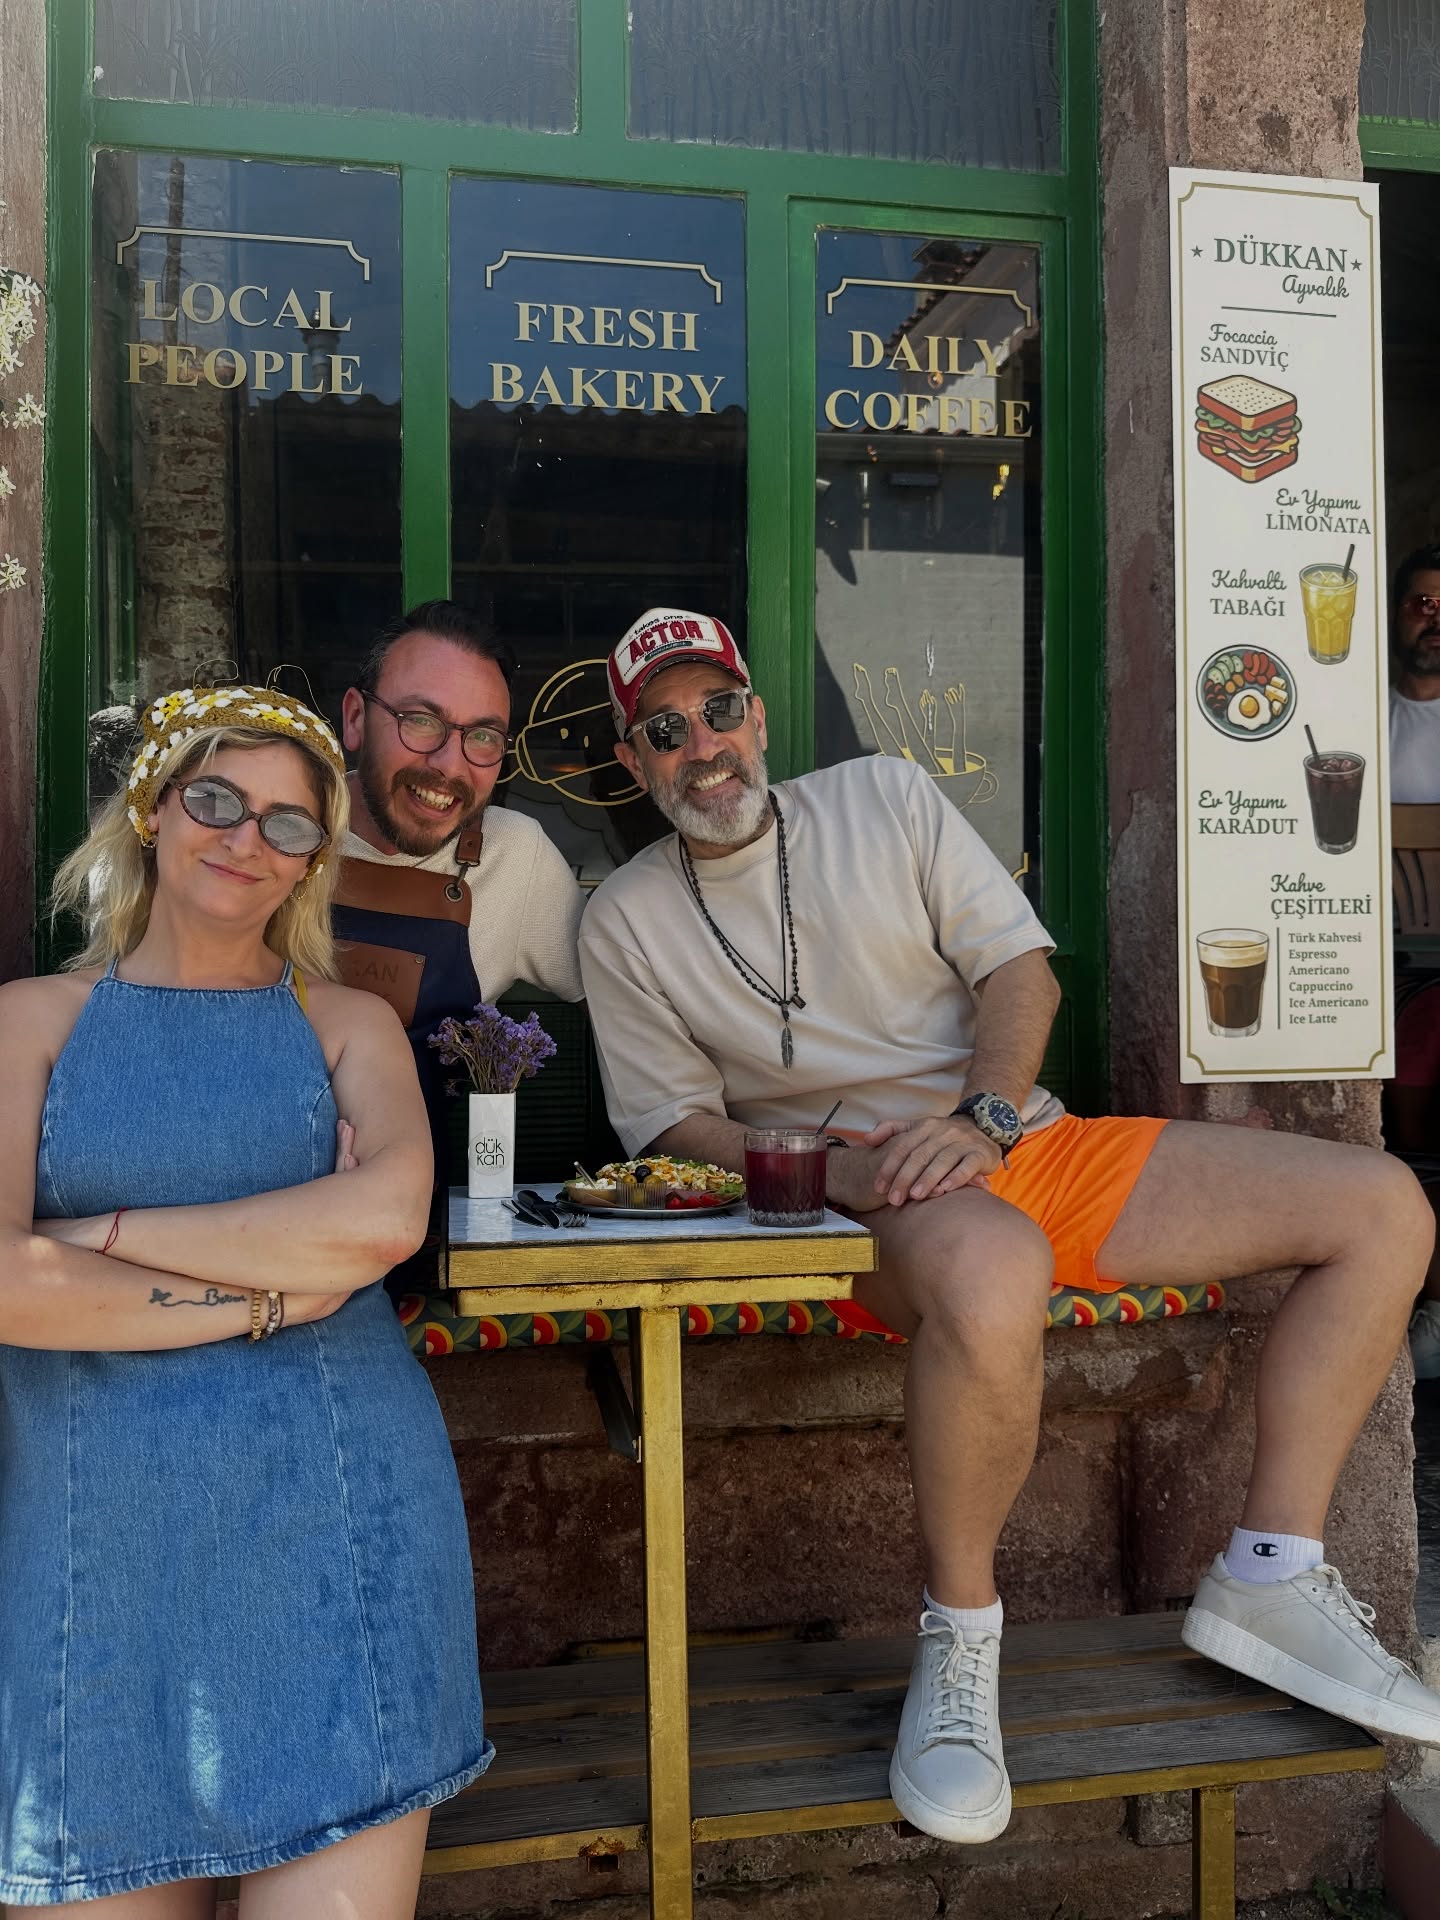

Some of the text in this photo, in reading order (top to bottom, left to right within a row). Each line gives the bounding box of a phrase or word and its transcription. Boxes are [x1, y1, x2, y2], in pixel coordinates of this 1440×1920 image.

[1214, 234, 1348, 273] DÜKKAN
[1282, 274, 1350, 304] Ayvalık
[140, 279, 352, 333] LOCAL
[514, 302, 701, 352] FRESH
[1208, 323, 1278, 346] Focaccia
[848, 330, 1003, 378] DAILY
[1200, 346, 1289, 372] SANDVİÇ
[124, 343, 364, 396] PEOPLE
[488, 363, 726, 414] BAKERY
[825, 389, 1033, 438] COFFEE
[1276, 488, 1361, 517] Ev Yapımı
[1266, 510, 1371, 535] LİMONATA
[1211, 568, 1287, 590] Kahvaltı
[1210, 596, 1286, 617] TABAĞI
[628, 620, 704, 664] ACTOR
[1198, 790, 1287, 818] Ev Yapımı
[1198, 817, 1298, 835] KARADUT
[1270, 872, 1326, 893] Kahve
[1270, 894, 1373, 919] ÇEŞİTLERİ
[1288, 932, 1363, 943] Türk Kahvesi
[1288, 949, 1338, 962] Espresso
[1288, 965, 1350, 975] Americano
[1288, 981, 1354, 994] Cappuccino
[1289, 997, 1369, 1008] Ice Americano
[1289, 1014, 1337, 1024] Ice Latte
[475, 1136, 505, 1154] dük
[477, 1154, 505, 1166] kan
